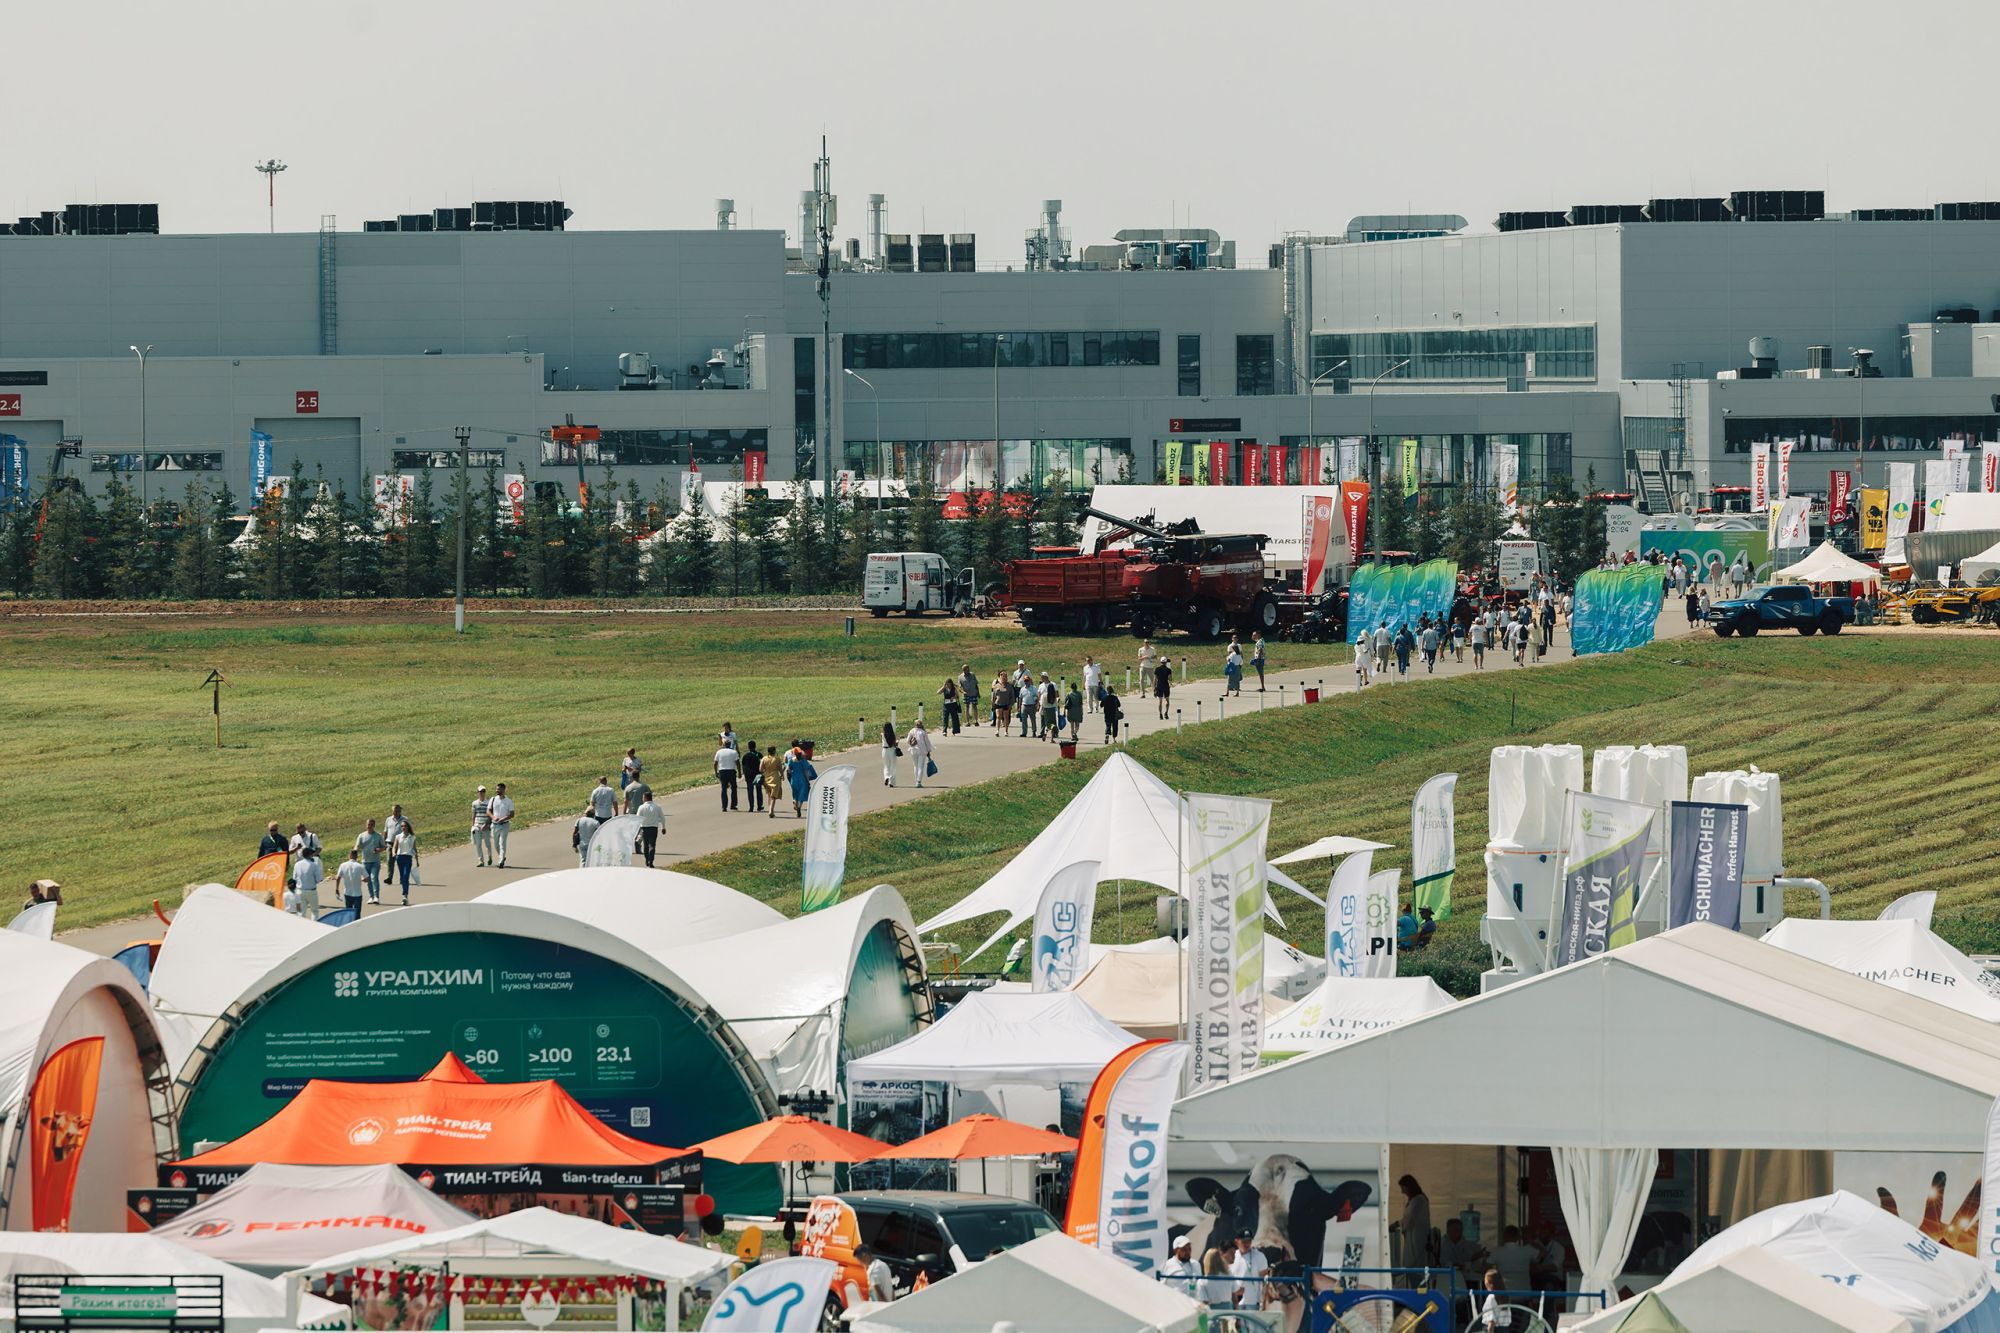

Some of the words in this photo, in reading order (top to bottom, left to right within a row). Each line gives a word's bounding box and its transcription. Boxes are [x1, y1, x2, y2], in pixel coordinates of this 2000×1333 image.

[0, 400, 20, 411] 2.4
[297, 397, 318, 408] 2.5
[1173, 421, 1180, 430] 2
[1756, 454, 1765, 507] КИРОВЕЦ
[1696, 807, 1716, 921] SCHUMACHER
[1727, 847, 1737, 882] Perfect
[1197, 876, 1207, 990] павловская-нива.рф
[364, 969, 483, 987] УРАЛХИМ
[501, 970, 535, 981] Потому
[536, 971, 552, 979] что
[554, 970, 571, 980] еда
[1208, 873, 1230, 1084] ПАВЛОВСКАЯ
[365, 989, 399, 997] ГРУППА
[400, 987, 448, 997] КОМПАНИЙ
[501, 982, 531, 991] нужна
[533, 981, 574, 991] каждому
[528, 1047, 573, 1063] >100
[596, 1046, 632, 1063] 23,1
[1194, 1011, 1204, 1084] АГРОФИРМА
[880, 1082, 917, 1090] АРКОС
[396, 1114, 492, 1132] ТИАН-ТРЕЙД
[444, 1167, 543, 1186] ТИАН-ТРЕЙД
[562, 1172, 643, 1185] tian-trade.ru
[245, 1215, 426, 1234] РЕММАШ
